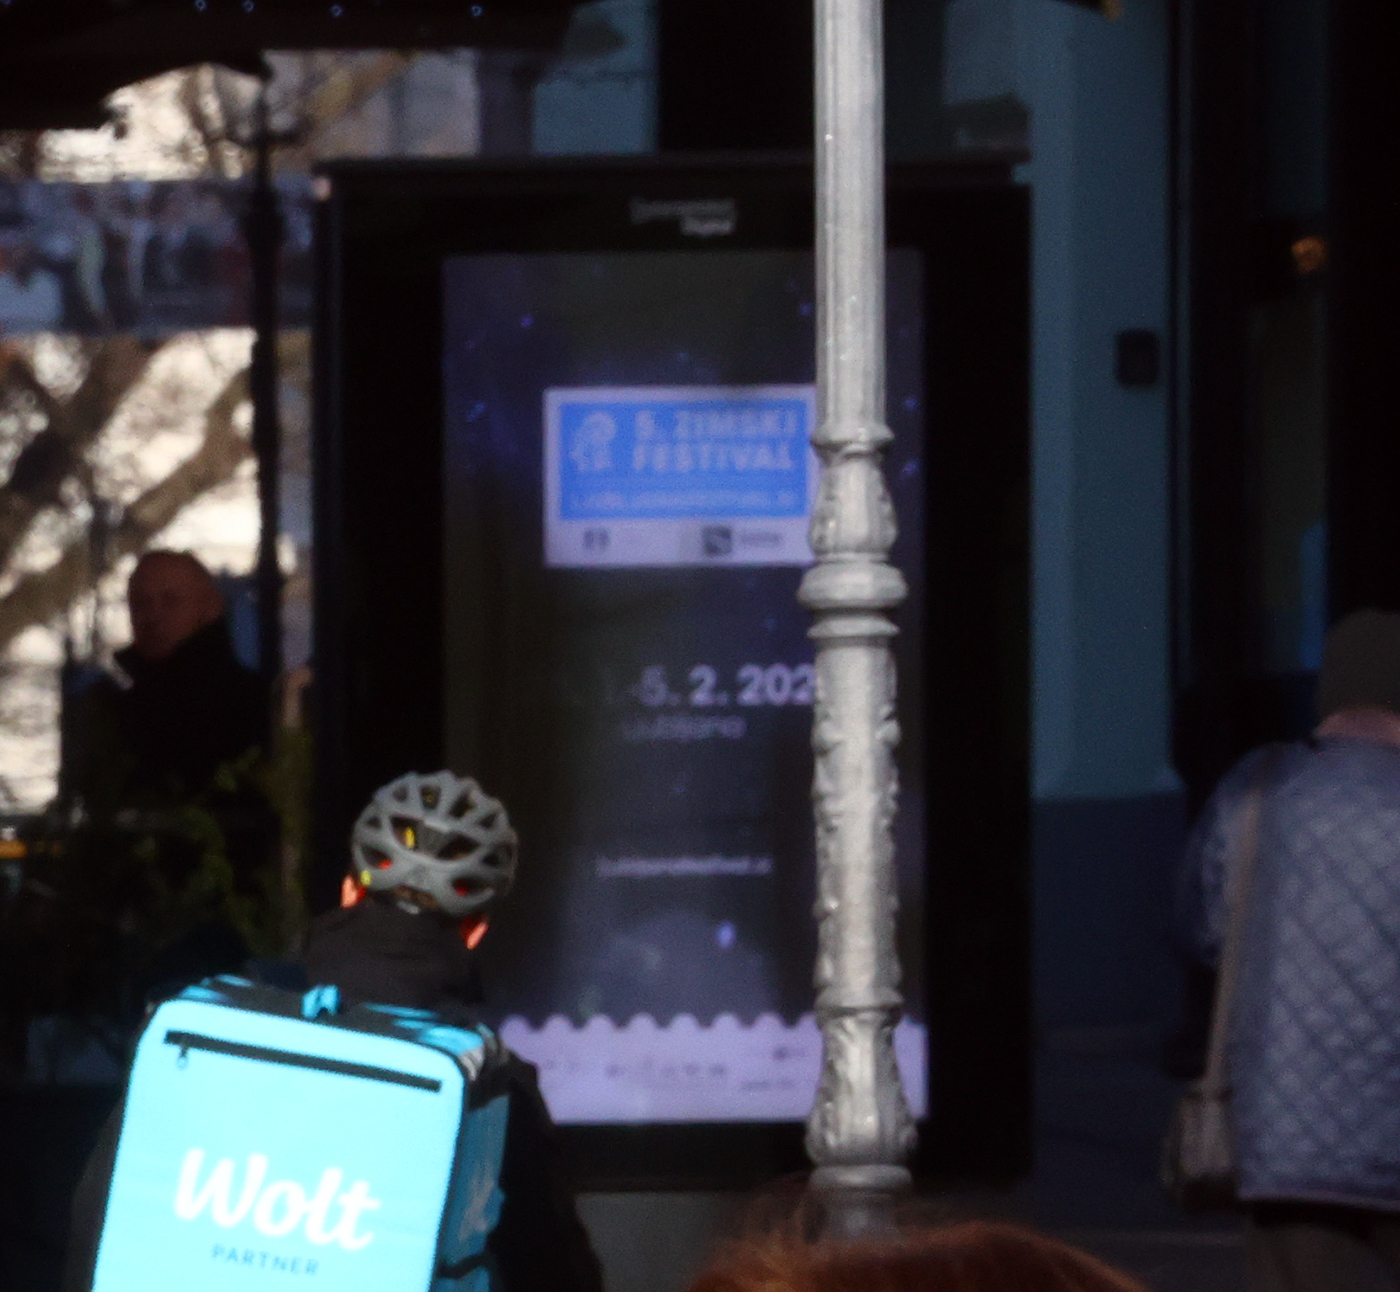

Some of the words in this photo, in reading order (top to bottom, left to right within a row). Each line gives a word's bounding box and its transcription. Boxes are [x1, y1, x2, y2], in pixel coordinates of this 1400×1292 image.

[675, 408, 797, 441] ZIMSKI
[632, 440, 793, 473] FESTIVAL
[687, 663, 728, 706] 2.
[735, 663, 816, 706] 202
[173, 1146, 383, 1253] Wolt
[210, 1242, 320, 1277] PARTNER
